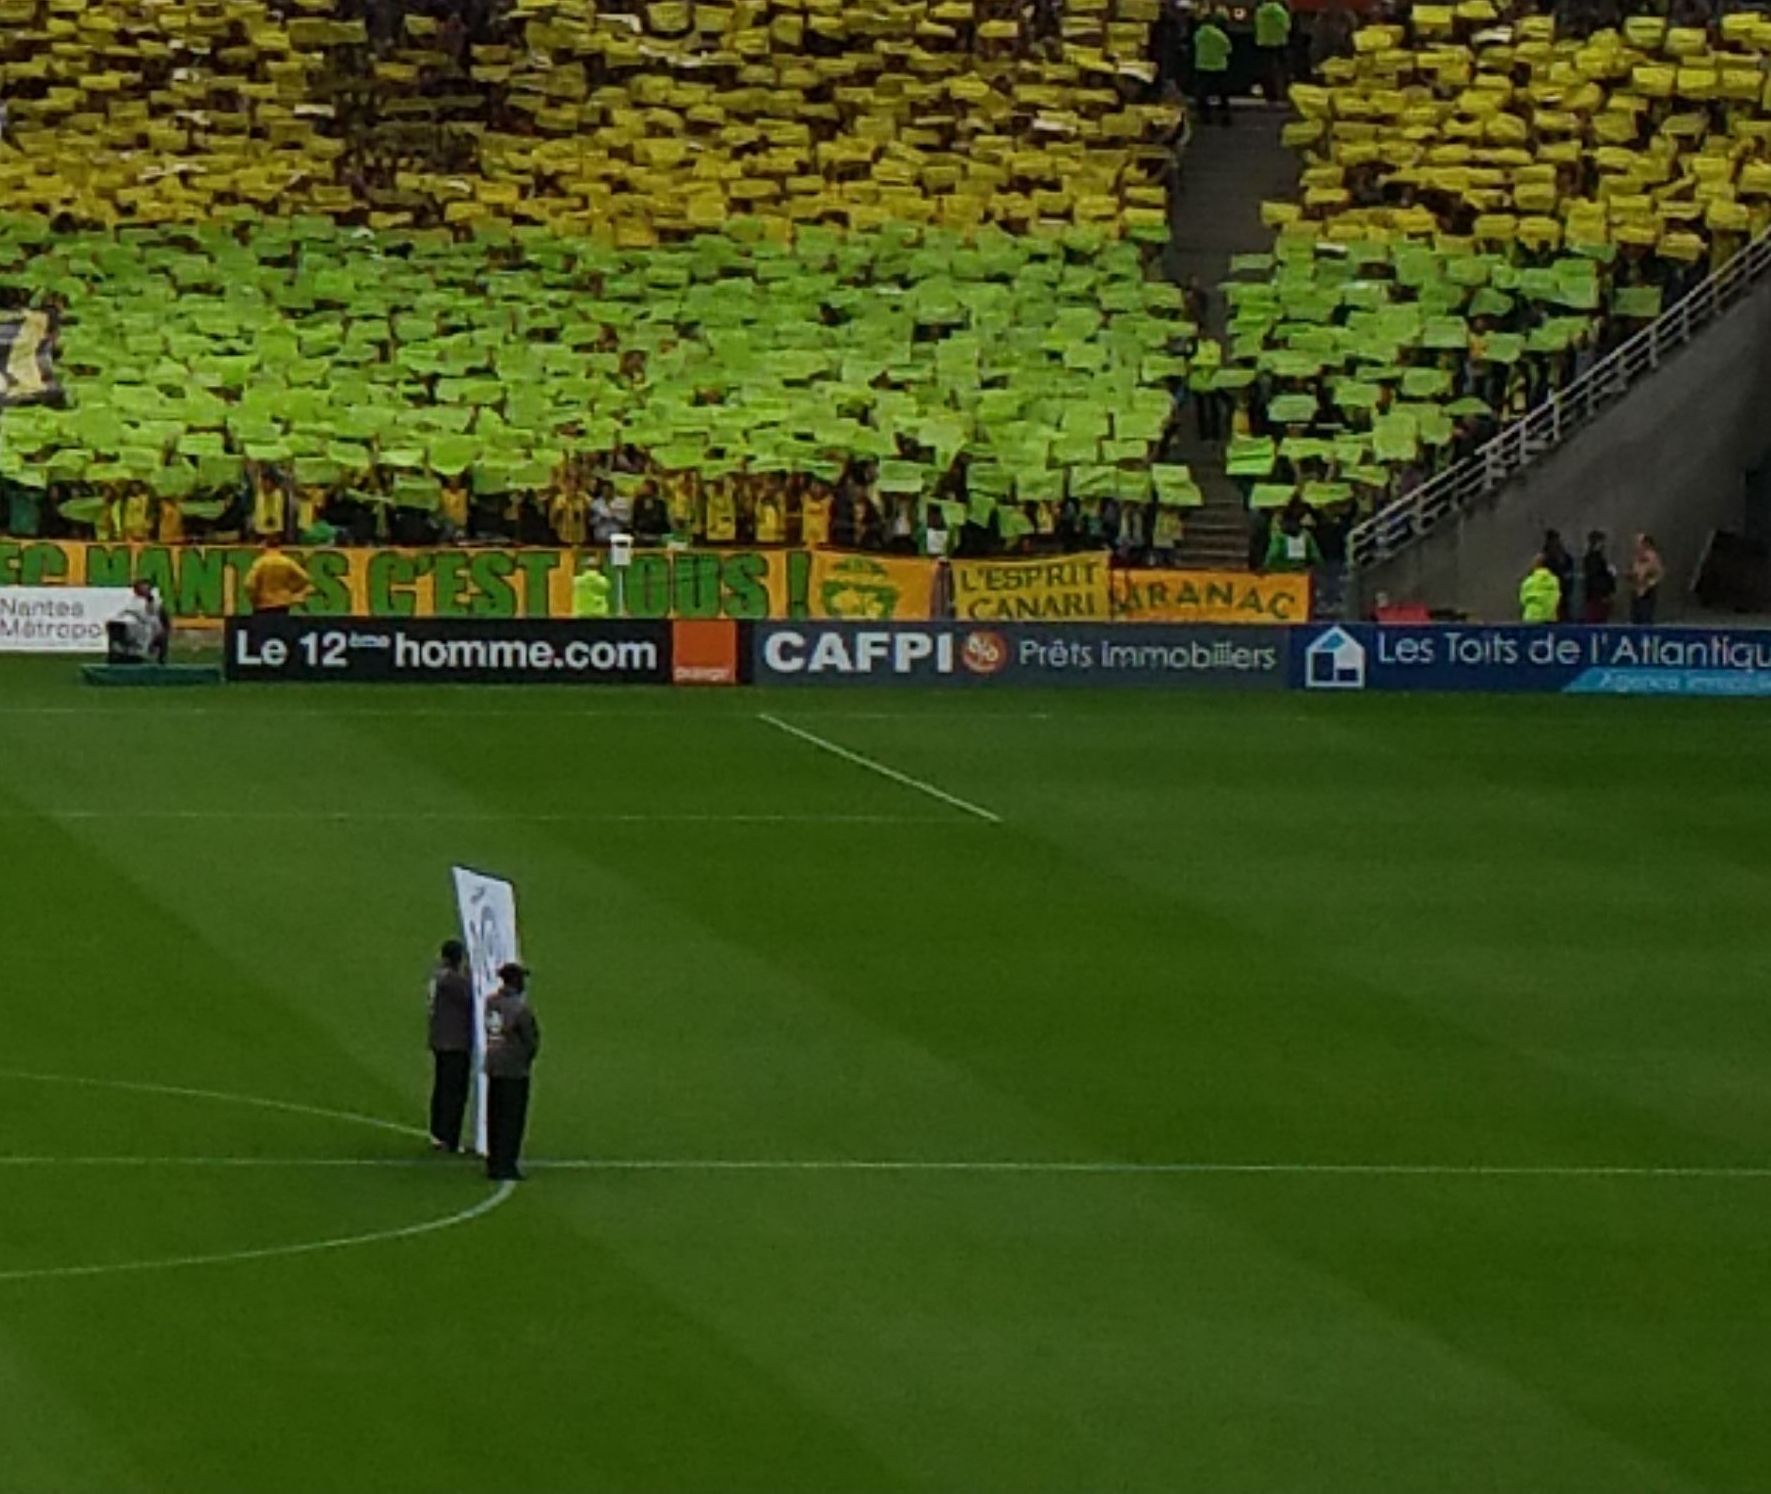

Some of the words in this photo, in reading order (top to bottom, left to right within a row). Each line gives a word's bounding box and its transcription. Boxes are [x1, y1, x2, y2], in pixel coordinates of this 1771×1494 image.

[369, 550, 560, 619] C'EST
[961, 562, 1097, 592] L'ESPRIT
[968, 592, 1095, 620] CANARI
[237, 630, 288, 666] Le
[764, 630, 954, 674] CAFPI
[1019, 637, 1094, 669] Prêts
[1378, 632, 1434, 664] Les
[1444, 631, 1519, 664] Toits
[1528, 632, 1581, 665] de
